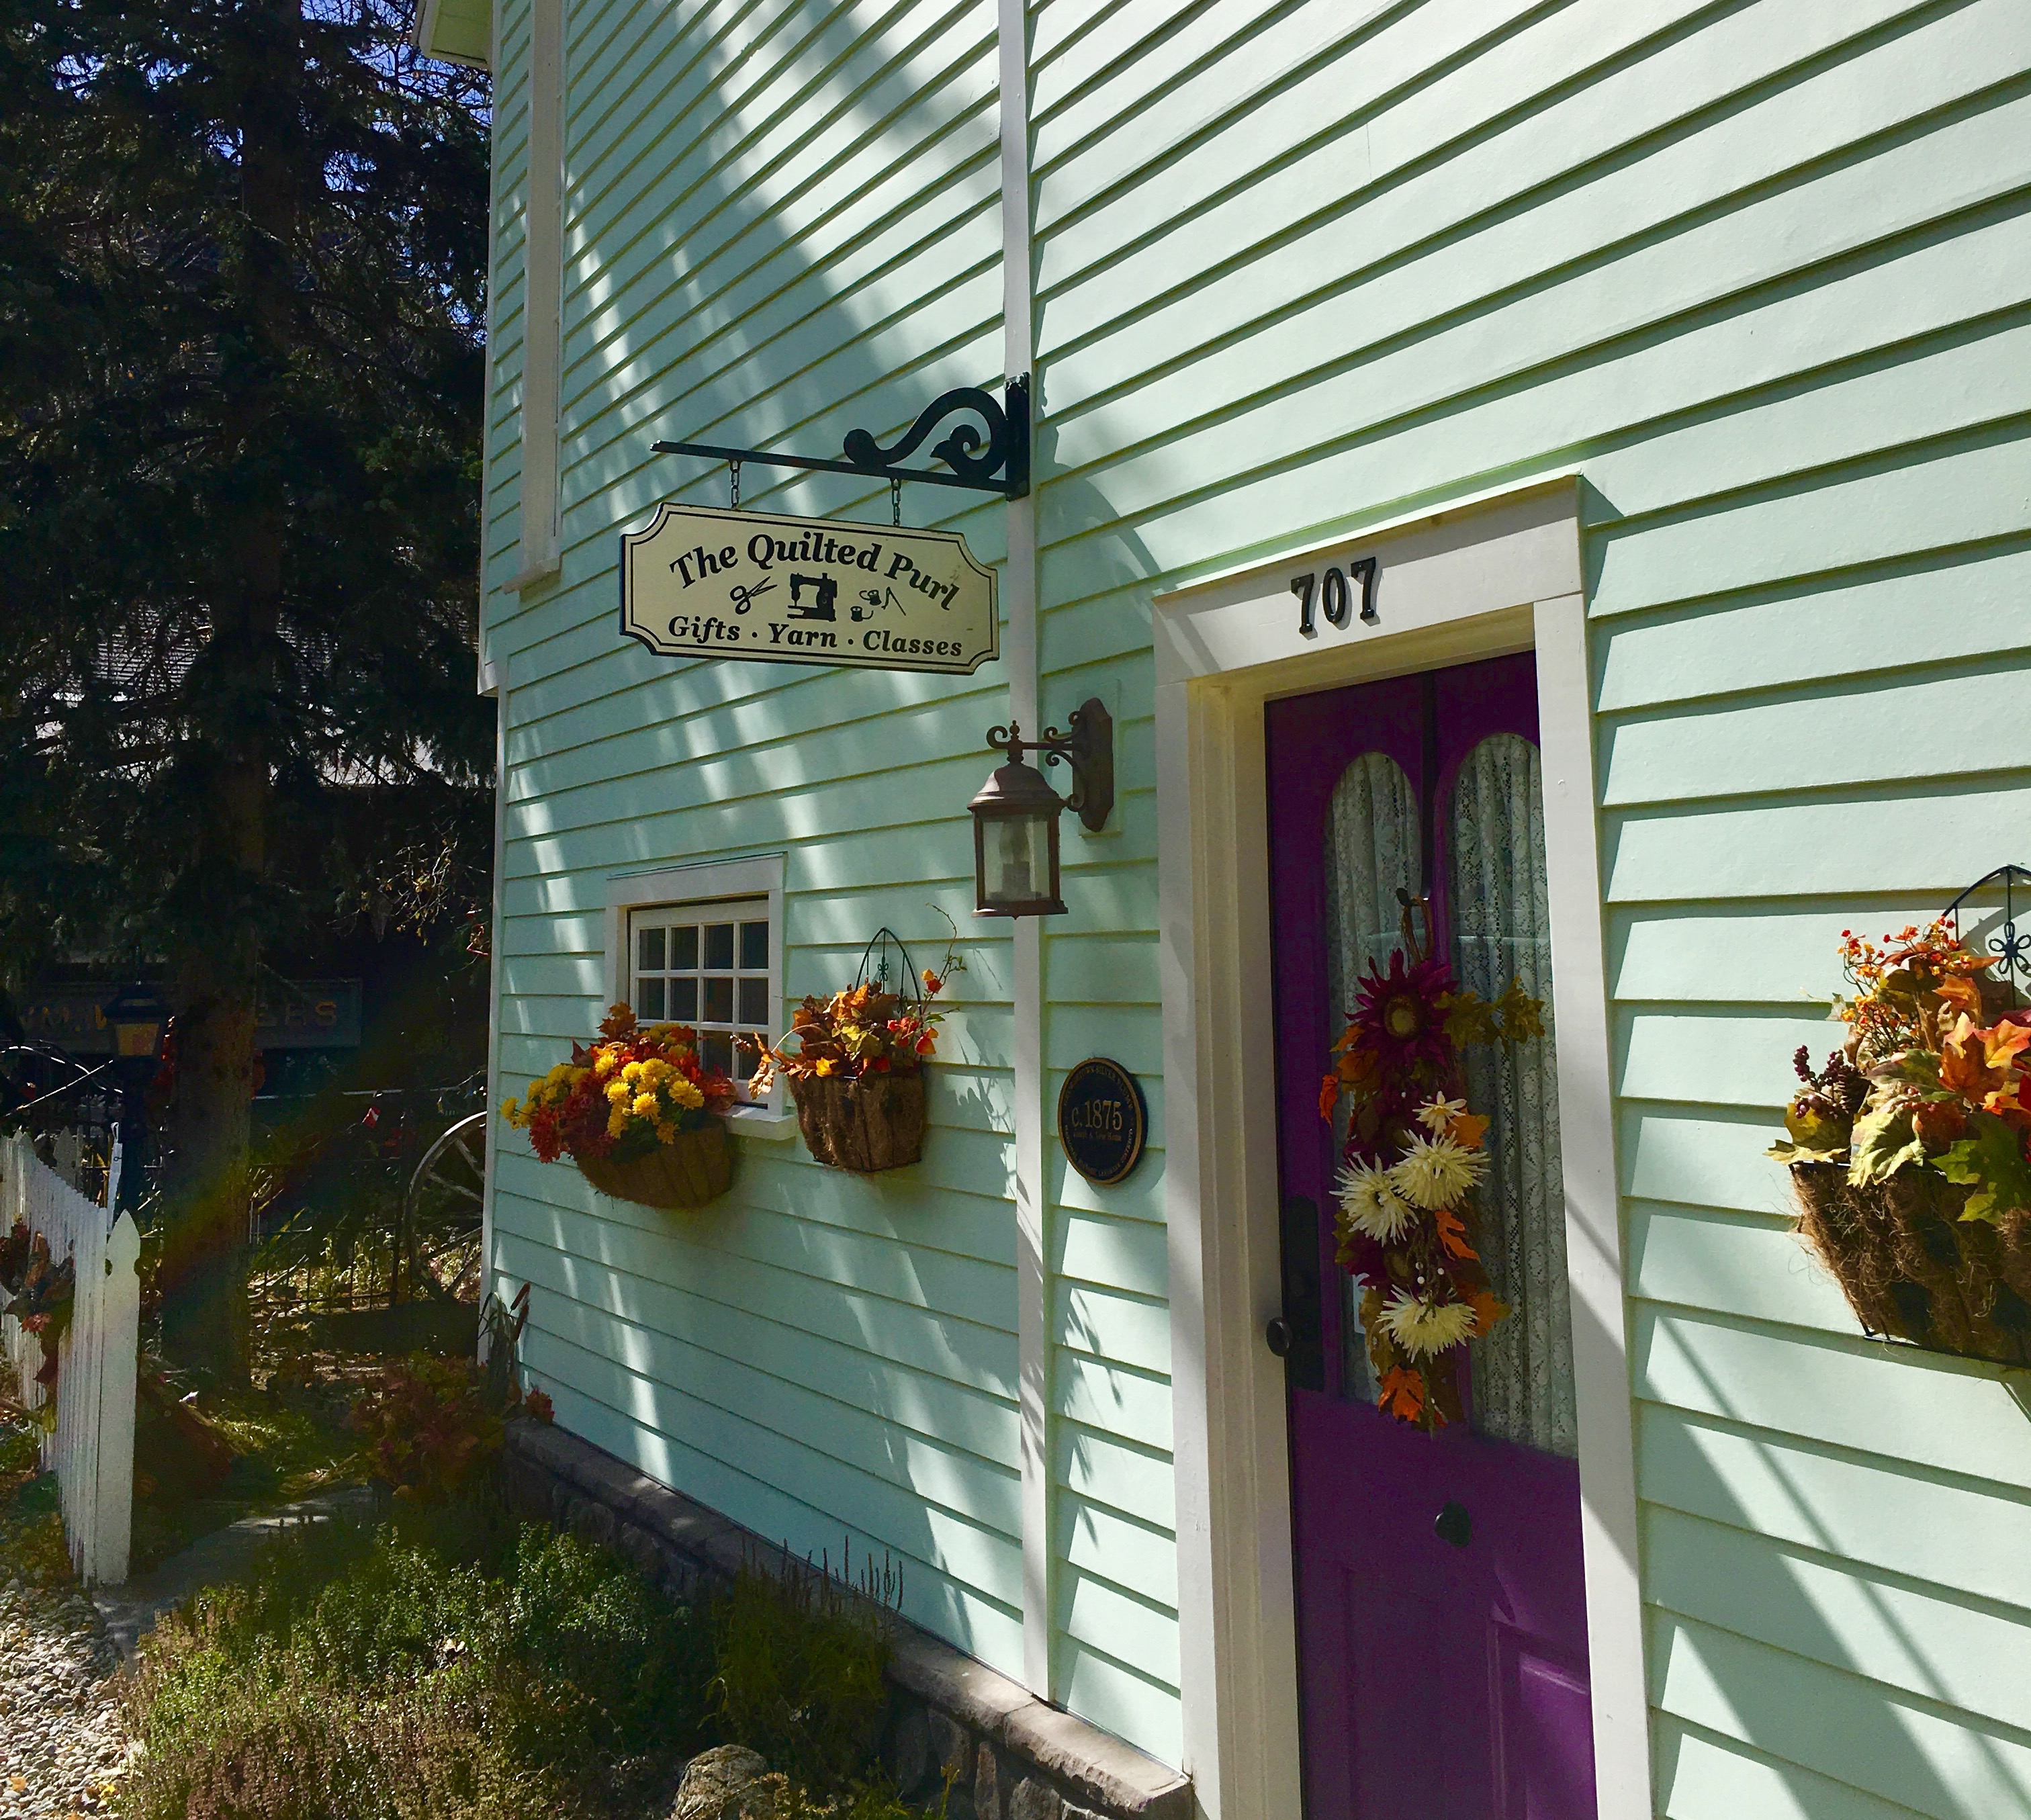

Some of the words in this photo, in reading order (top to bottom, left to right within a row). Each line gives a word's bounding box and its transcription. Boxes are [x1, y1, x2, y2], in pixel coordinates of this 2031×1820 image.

[670, 545, 738, 590] The
[748, 531, 882, 573] Quilted
[884, 552, 960, 611] Purl
[1290, 556, 1376, 634] 707
[668, 616, 740, 644] Gifts
[768, 622, 838, 648] Yarn
[862, 629, 962, 657] Classes
